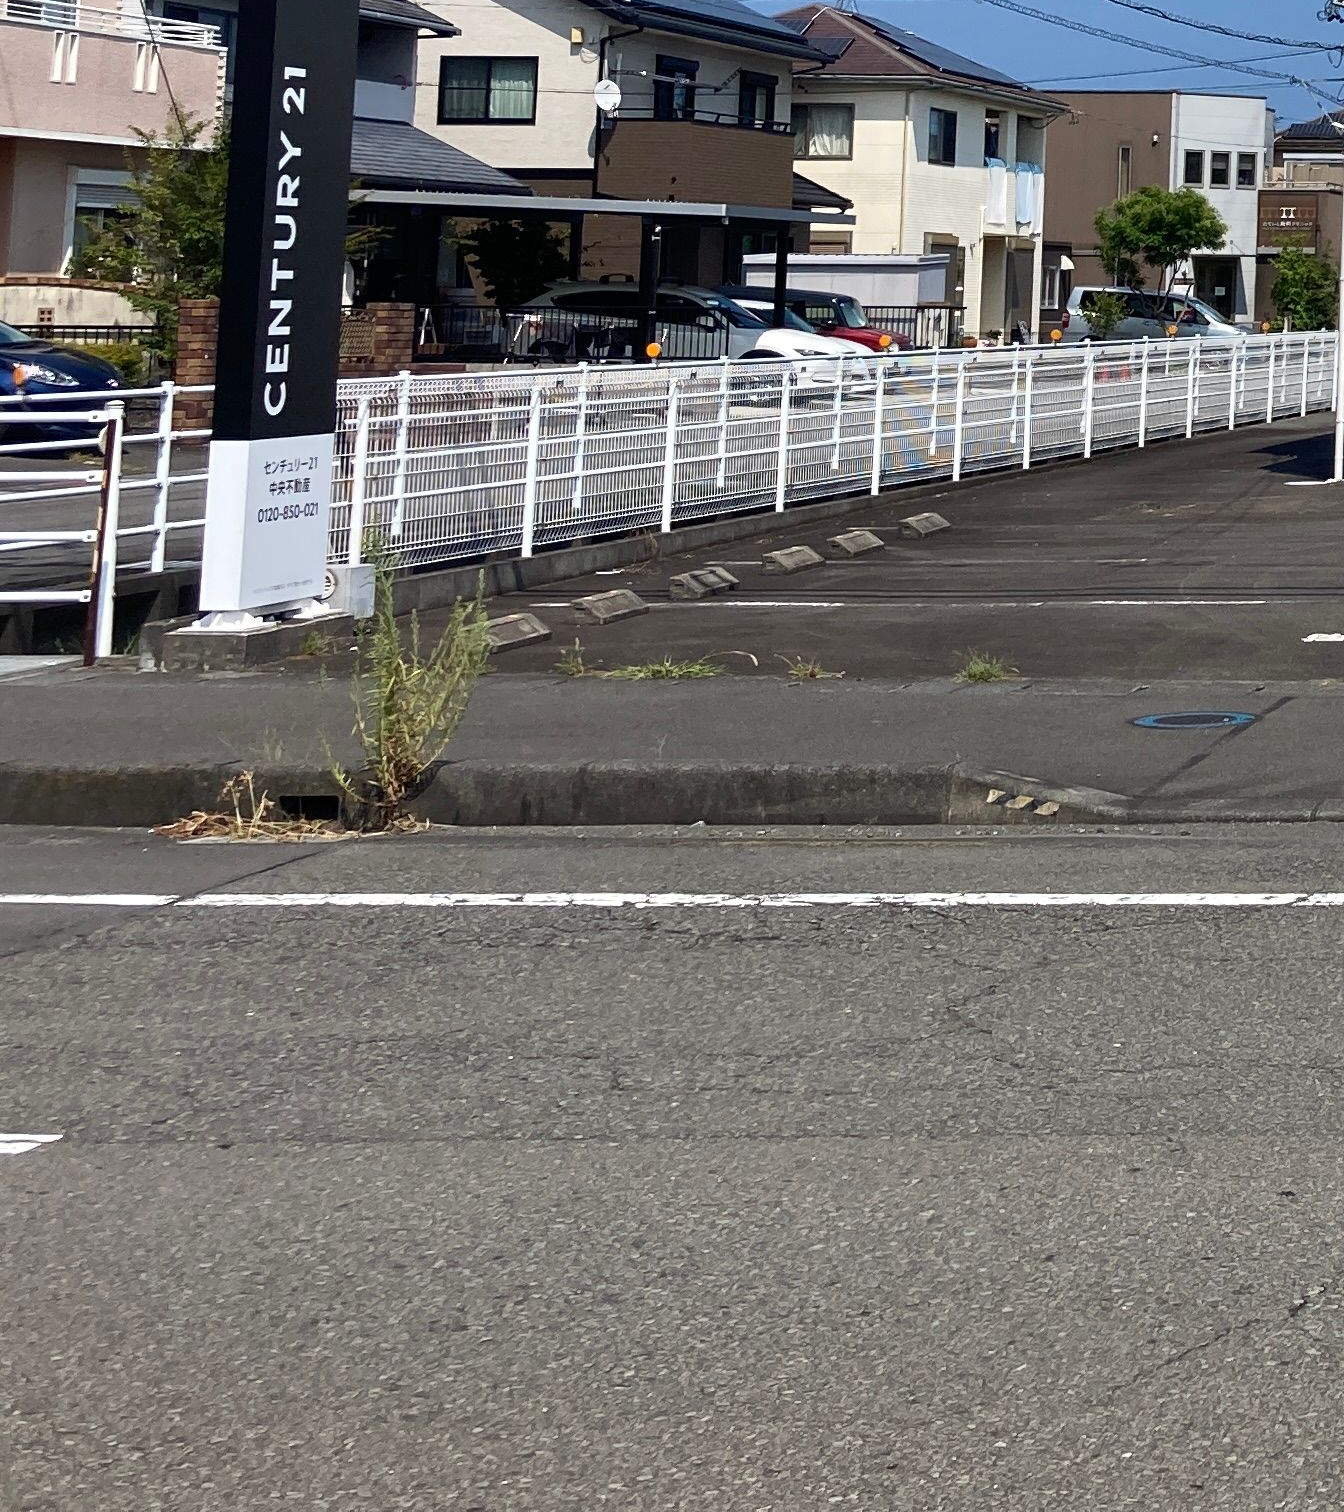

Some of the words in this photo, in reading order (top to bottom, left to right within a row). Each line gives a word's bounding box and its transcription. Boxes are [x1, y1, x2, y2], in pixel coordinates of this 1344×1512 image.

[282, 66, 307, 115] 21
[264, 130, 302, 417] CENTURY
[263, 456, 319, 475] センチュリー21
[269, 477, 311, 496] 中央不動産
[257, 502, 319, 523] 0120-850-021
